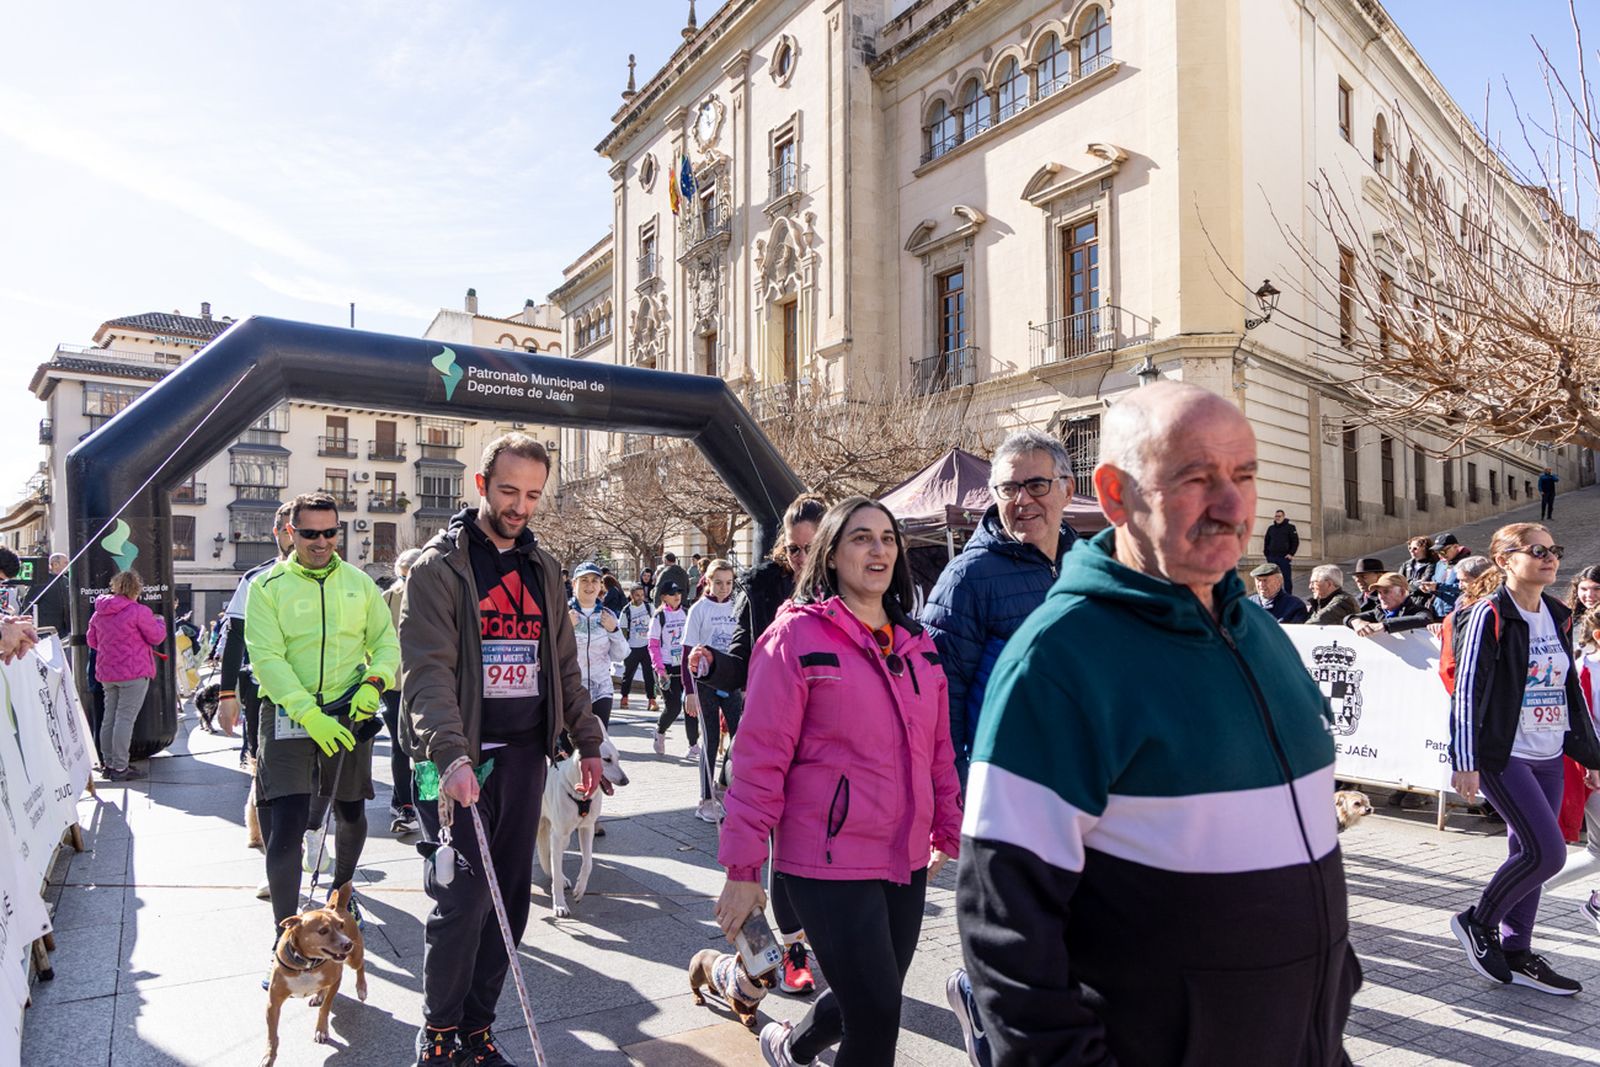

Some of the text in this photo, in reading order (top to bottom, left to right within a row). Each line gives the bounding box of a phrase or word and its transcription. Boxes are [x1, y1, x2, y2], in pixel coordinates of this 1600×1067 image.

[468, 366, 605, 392] Patronato Municipal de
[467, 380, 574, 402] Deportes de Jaén
[143, 593, 162, 601] Jaén
[487, 665, 527, 685] 949
[1533, 706, 1561, 722] 939
[1345, 745, 1378, 759] JAÉN
